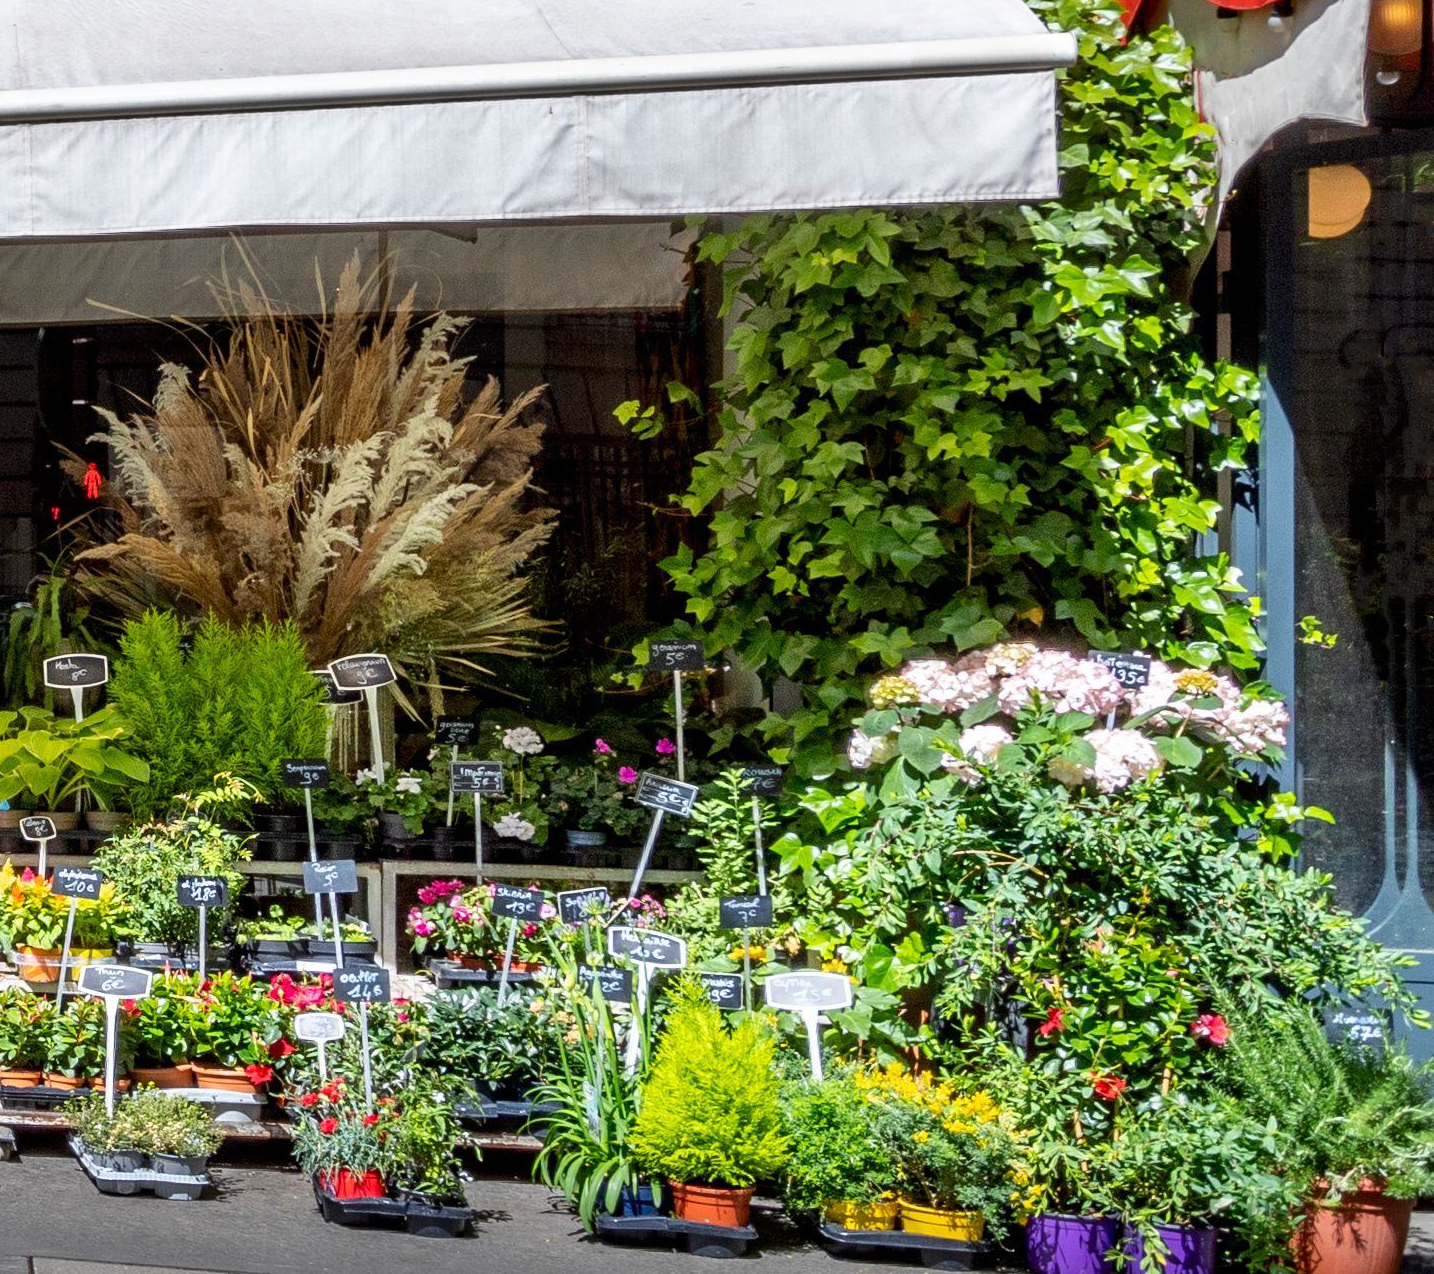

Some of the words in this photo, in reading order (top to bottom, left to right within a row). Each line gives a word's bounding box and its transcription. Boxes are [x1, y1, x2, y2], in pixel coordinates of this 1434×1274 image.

[665, 653, 685, 665] 5€
[1111, 667, 1146, 685] 135€
[655, 791, 682, 803] 5€
[64, 879, 95, 893] 10€
[505, 901, 536, 914] 13€
[101, 978, 126, 991] 6€
